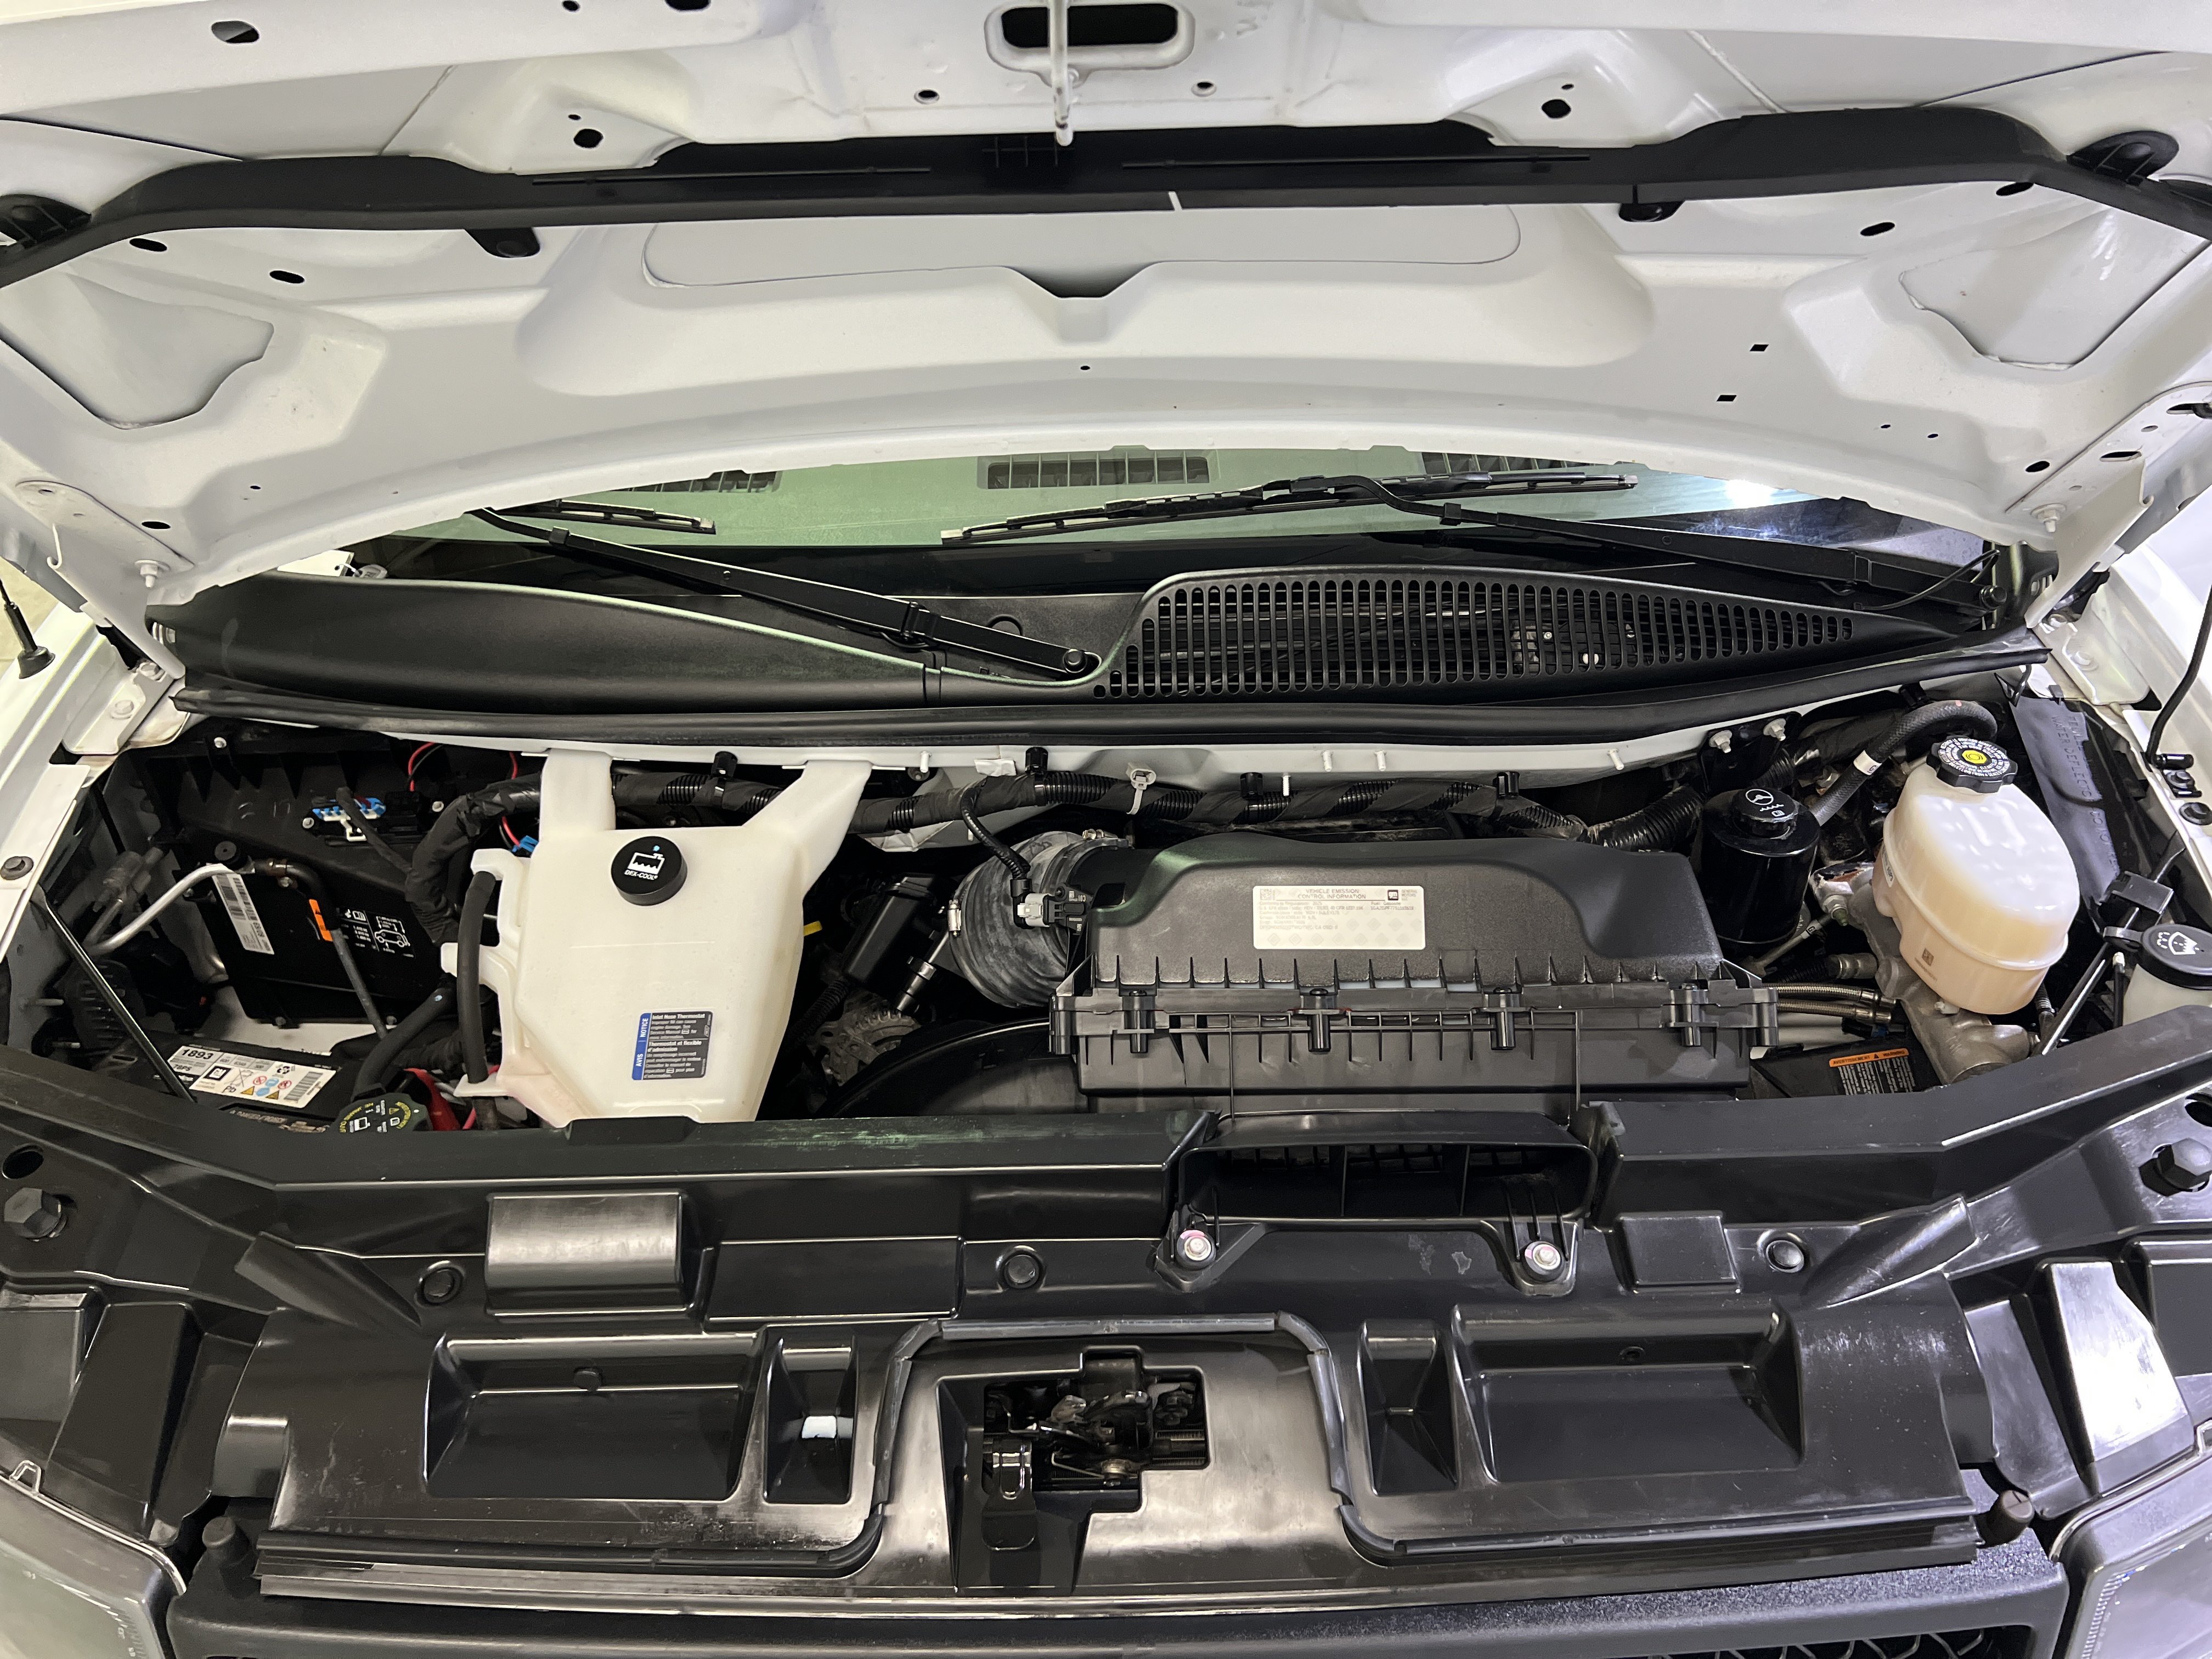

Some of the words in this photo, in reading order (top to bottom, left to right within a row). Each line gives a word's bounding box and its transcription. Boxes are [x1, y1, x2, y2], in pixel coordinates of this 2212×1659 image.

[2051, 716, 2069, 744] WATER
[2063, 747, 2093, 801] DEFLECTO
[640, 1018, 648, 1037] NOTICE
[182, 1048, 214, 1060] 1893
[222, 1085, 236, 1093] Pb
